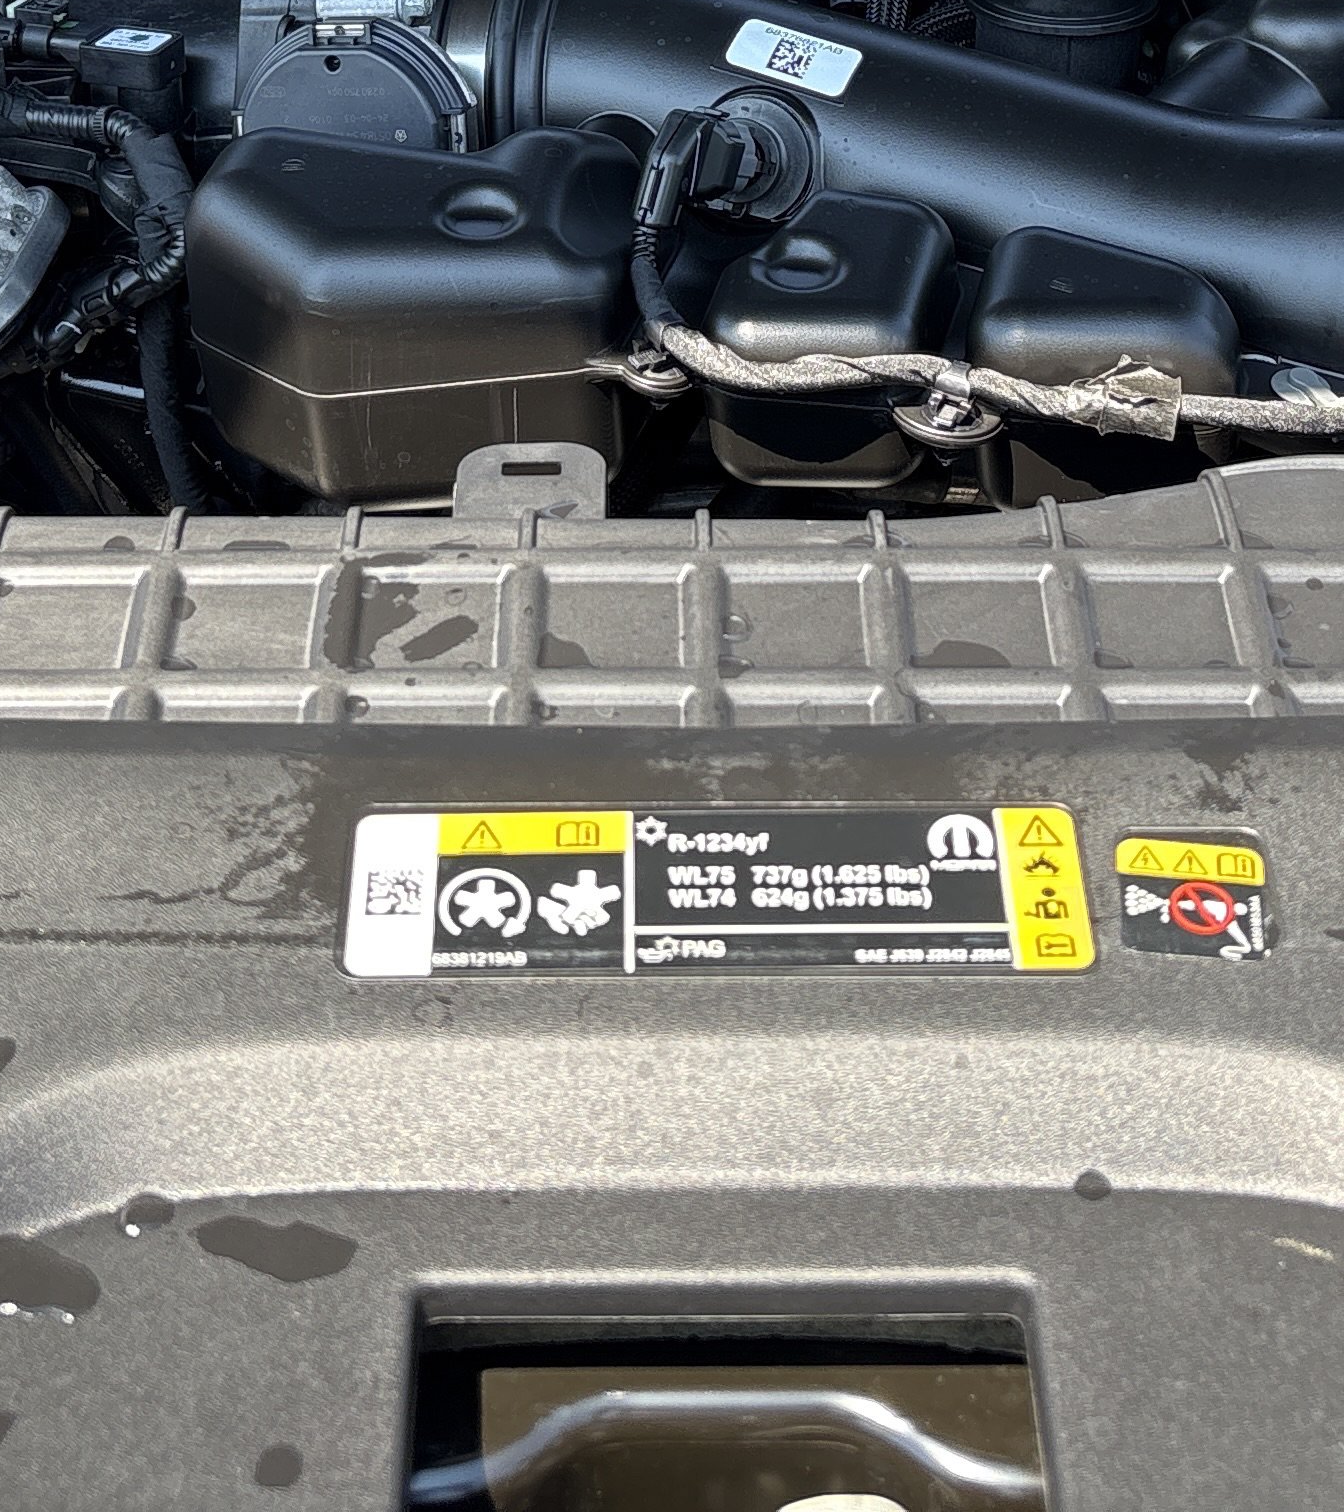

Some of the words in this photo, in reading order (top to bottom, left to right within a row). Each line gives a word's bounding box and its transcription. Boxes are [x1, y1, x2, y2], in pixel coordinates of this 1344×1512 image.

[667, 833, 770, 856] R-1234yf
[667, 865, 736, 886] WL75
[750, 865, 808, 888] 737g
[811, 864, 881, 886] (1.625
[884, 864, 930, 886] lbs)
[667, 888, 737, 908] WL74
[751, 887, 809, 911] 624g
[813, 887, 883, 910] (1.375
[886, 886, 933, 910] lbs)
[682, 940, 727, 958] PAG
